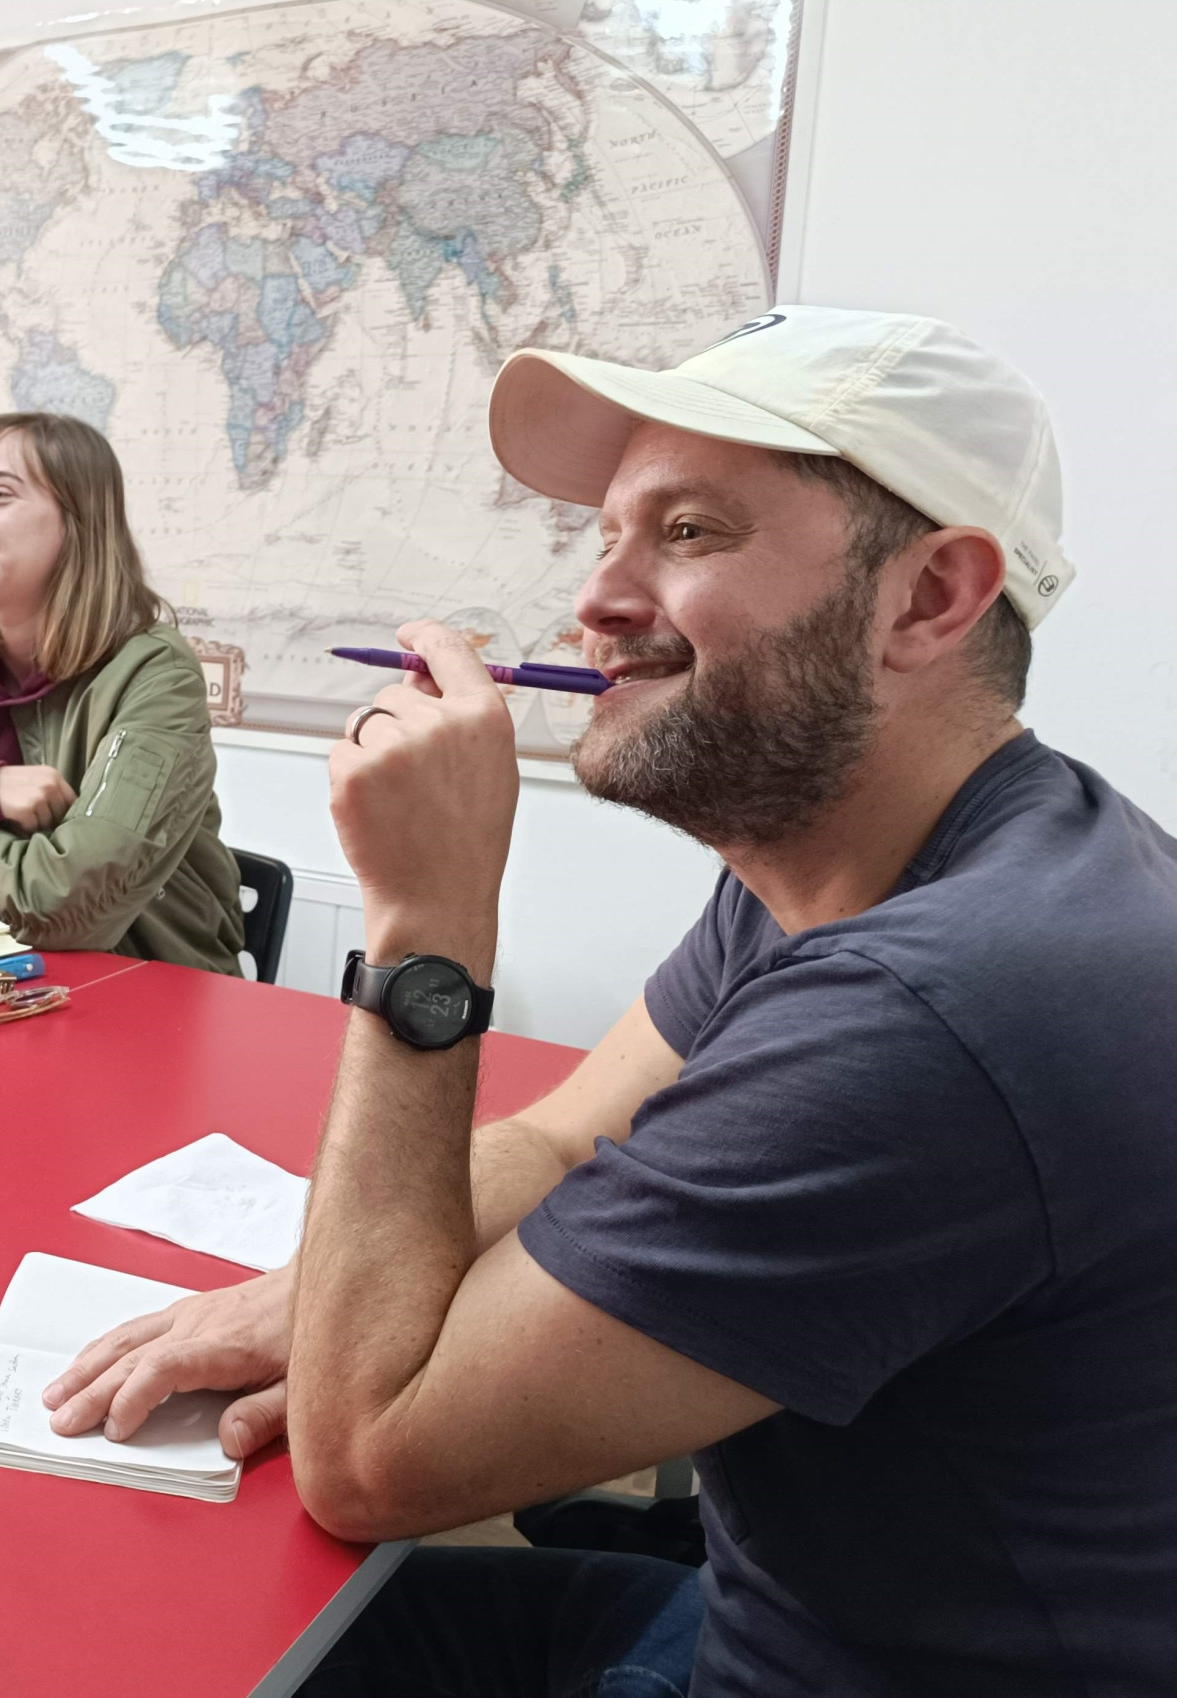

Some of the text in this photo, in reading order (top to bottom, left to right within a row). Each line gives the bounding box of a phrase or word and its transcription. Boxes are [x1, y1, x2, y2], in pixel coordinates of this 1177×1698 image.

[608, 128, 658, 149] NORTH
[630, 175, 689, 195] PACIFIC
[654, 225, 703, 240] OCEAN
[431, 993, 451, 1017] 23
